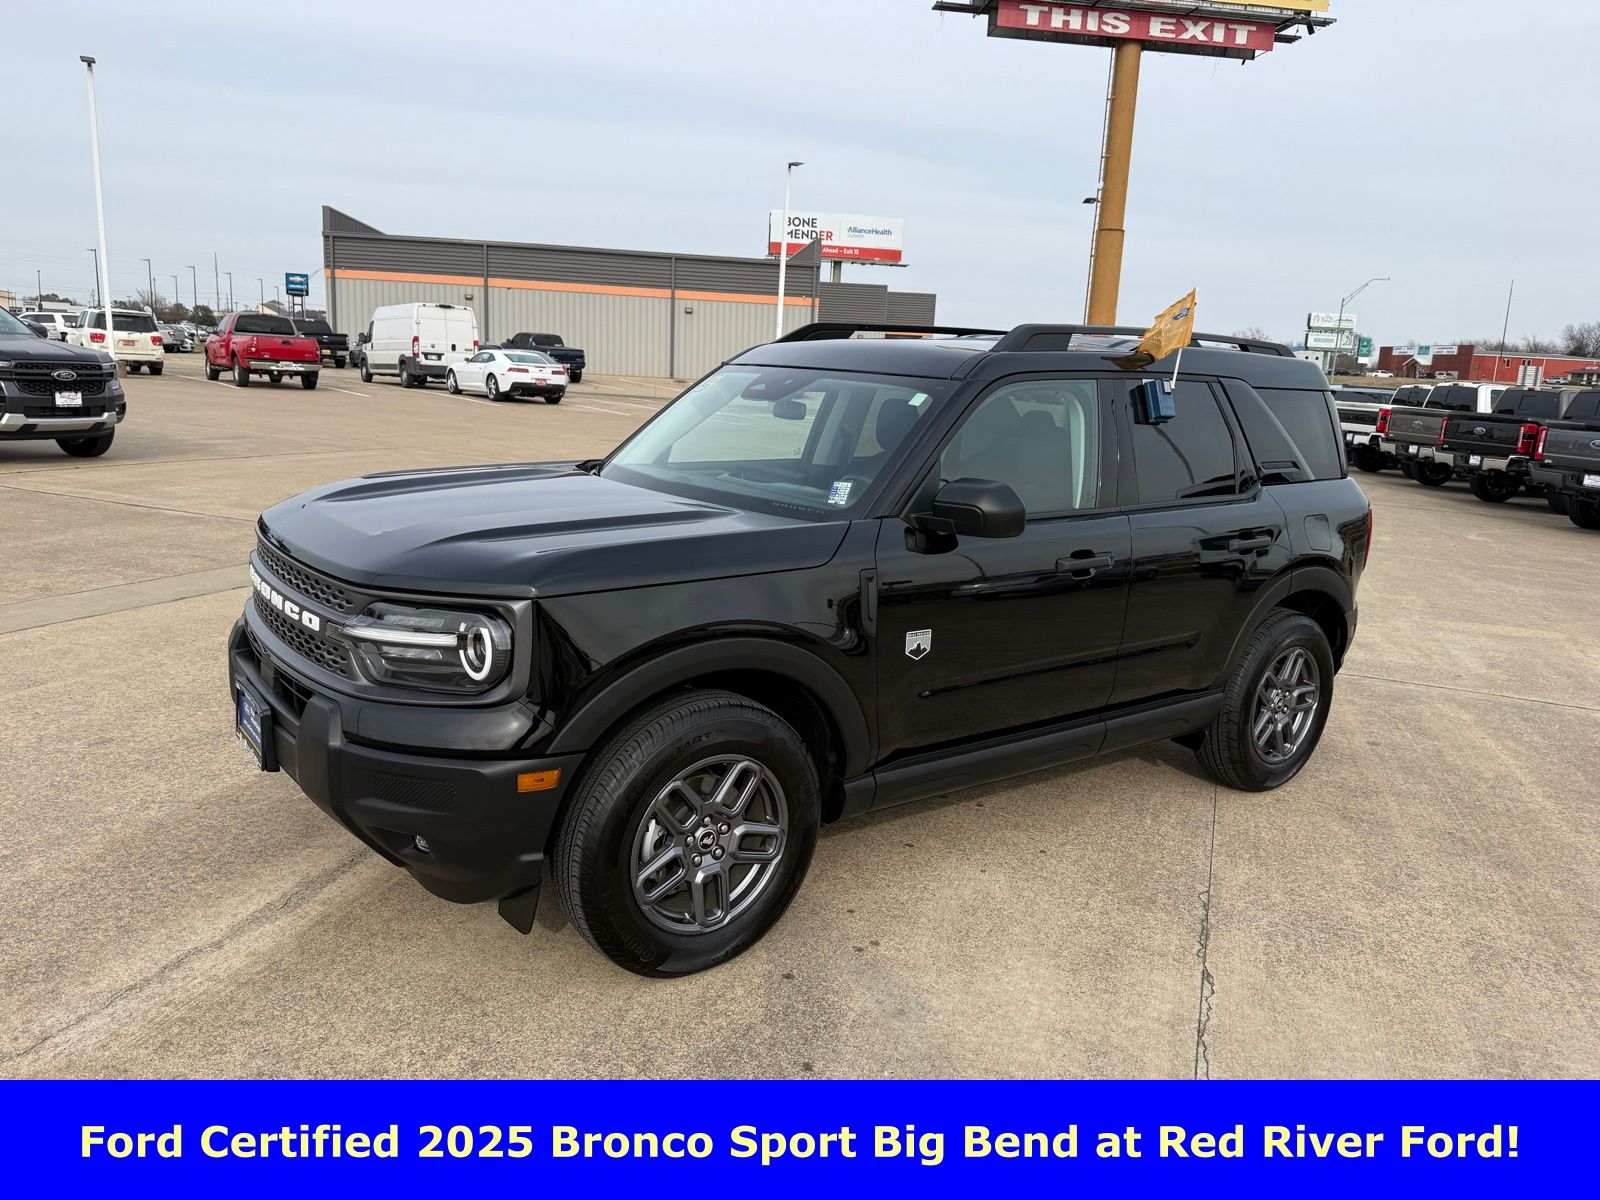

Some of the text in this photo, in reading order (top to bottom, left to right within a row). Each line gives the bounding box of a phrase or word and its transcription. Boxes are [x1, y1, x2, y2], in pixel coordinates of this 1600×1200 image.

[1019, 4, 1257, 45] THIS EXIT
[847, 226, 893, 236] AllianceHealth
